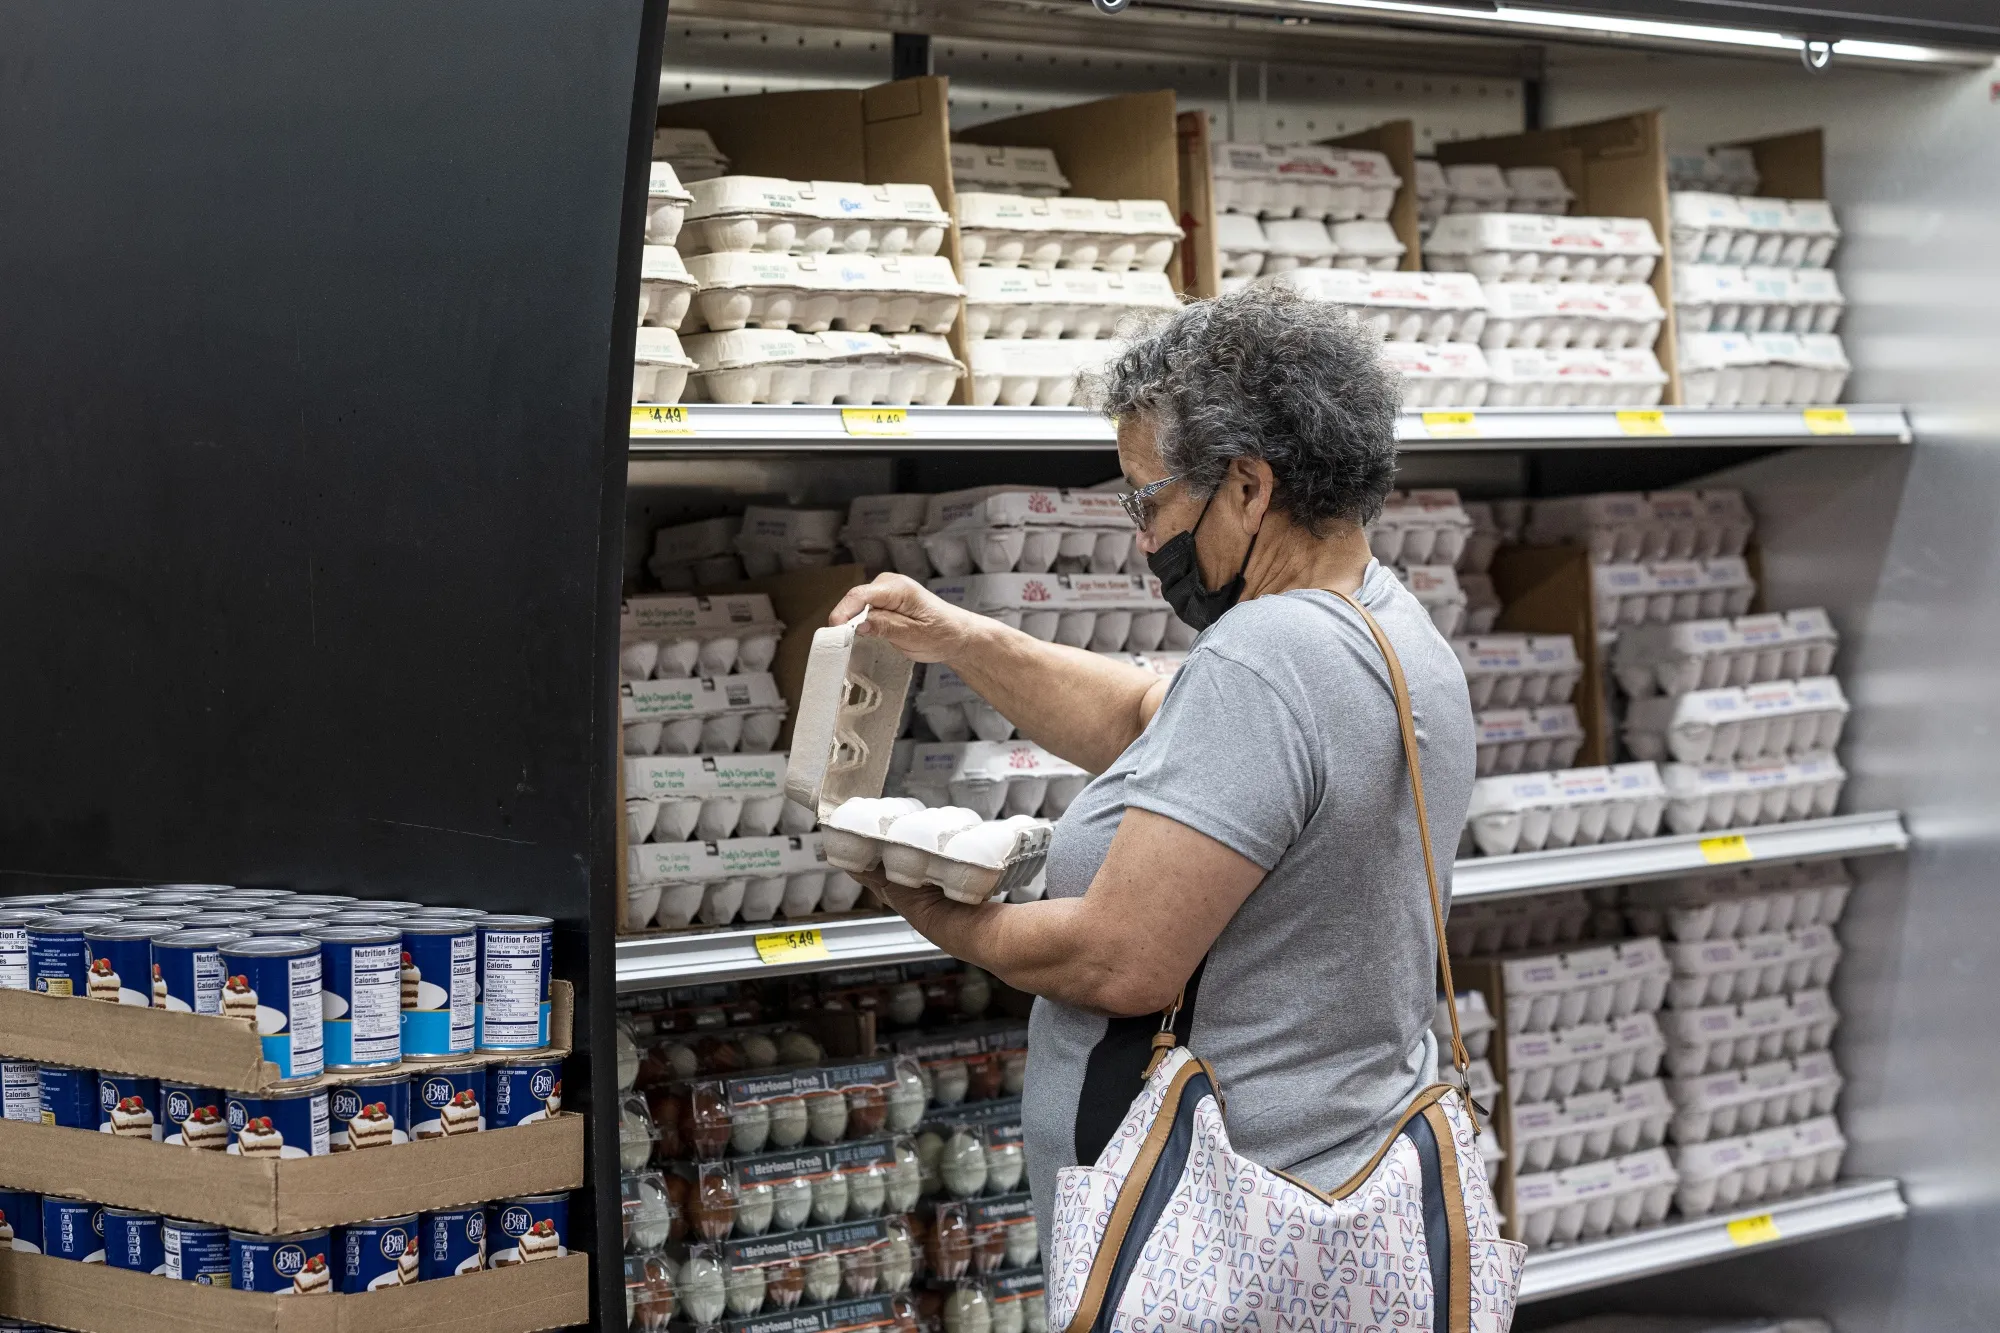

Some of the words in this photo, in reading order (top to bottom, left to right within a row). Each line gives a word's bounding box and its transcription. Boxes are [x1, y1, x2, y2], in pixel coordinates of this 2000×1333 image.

[735, 769, 759, 780] Organic
[741, 848, 763, 861] Organic
[659, 864, 673, 873] Our
[487, 935, 521, 944] Nutrition
[523, 935, 540, 944] Facts
[785, 931, 814, 949] $5.49
[196, 954, 219, 963] Nutrit
[354, 949, 386, 958] Nutrition
[453, 966, 471, 974] Calories
[486, 961, 513, 969] Calories
[531, 959, 540, 968] 40
[354, 976, 380, 984] Calories
[292, 987, 313, 997] Calories
[4, 1064, 37, 1073] Nutrition
[425, 1083, 450, 1101] BEST
[534, 1074, 552, 1093] BEST
[748, 1081, 792, 1094] Heirloom
[792, 1075, 820, 1089] Fresh
[333, 1095, 357, 1113] BEST
[437, 1093, 450, 1101] YET
[169, 1097, 188, 1116] BEST
[754, 1161, 796, 1176] Heirloom
[796, 1155, 823, 1169] Fresh
[504, 1212, 528, 1230] BEST
[384, 1234, 404, 1253] BEST
[745, 1245, 787, 1258] Heirloom
[787, 1239, 814, 1253] Fresh
[1193, 1222, 1298, 1260] NAUTICA
[277, 1251, 301, 1270] BEST
[1229, 1269, 1350, 1302] NAUTICA
[1143, 1280, 1261, 1328] NAUTICA
[750, 1323, 792, 1333] Heirloom
[792, 1315, 820, 1329] Fresh
